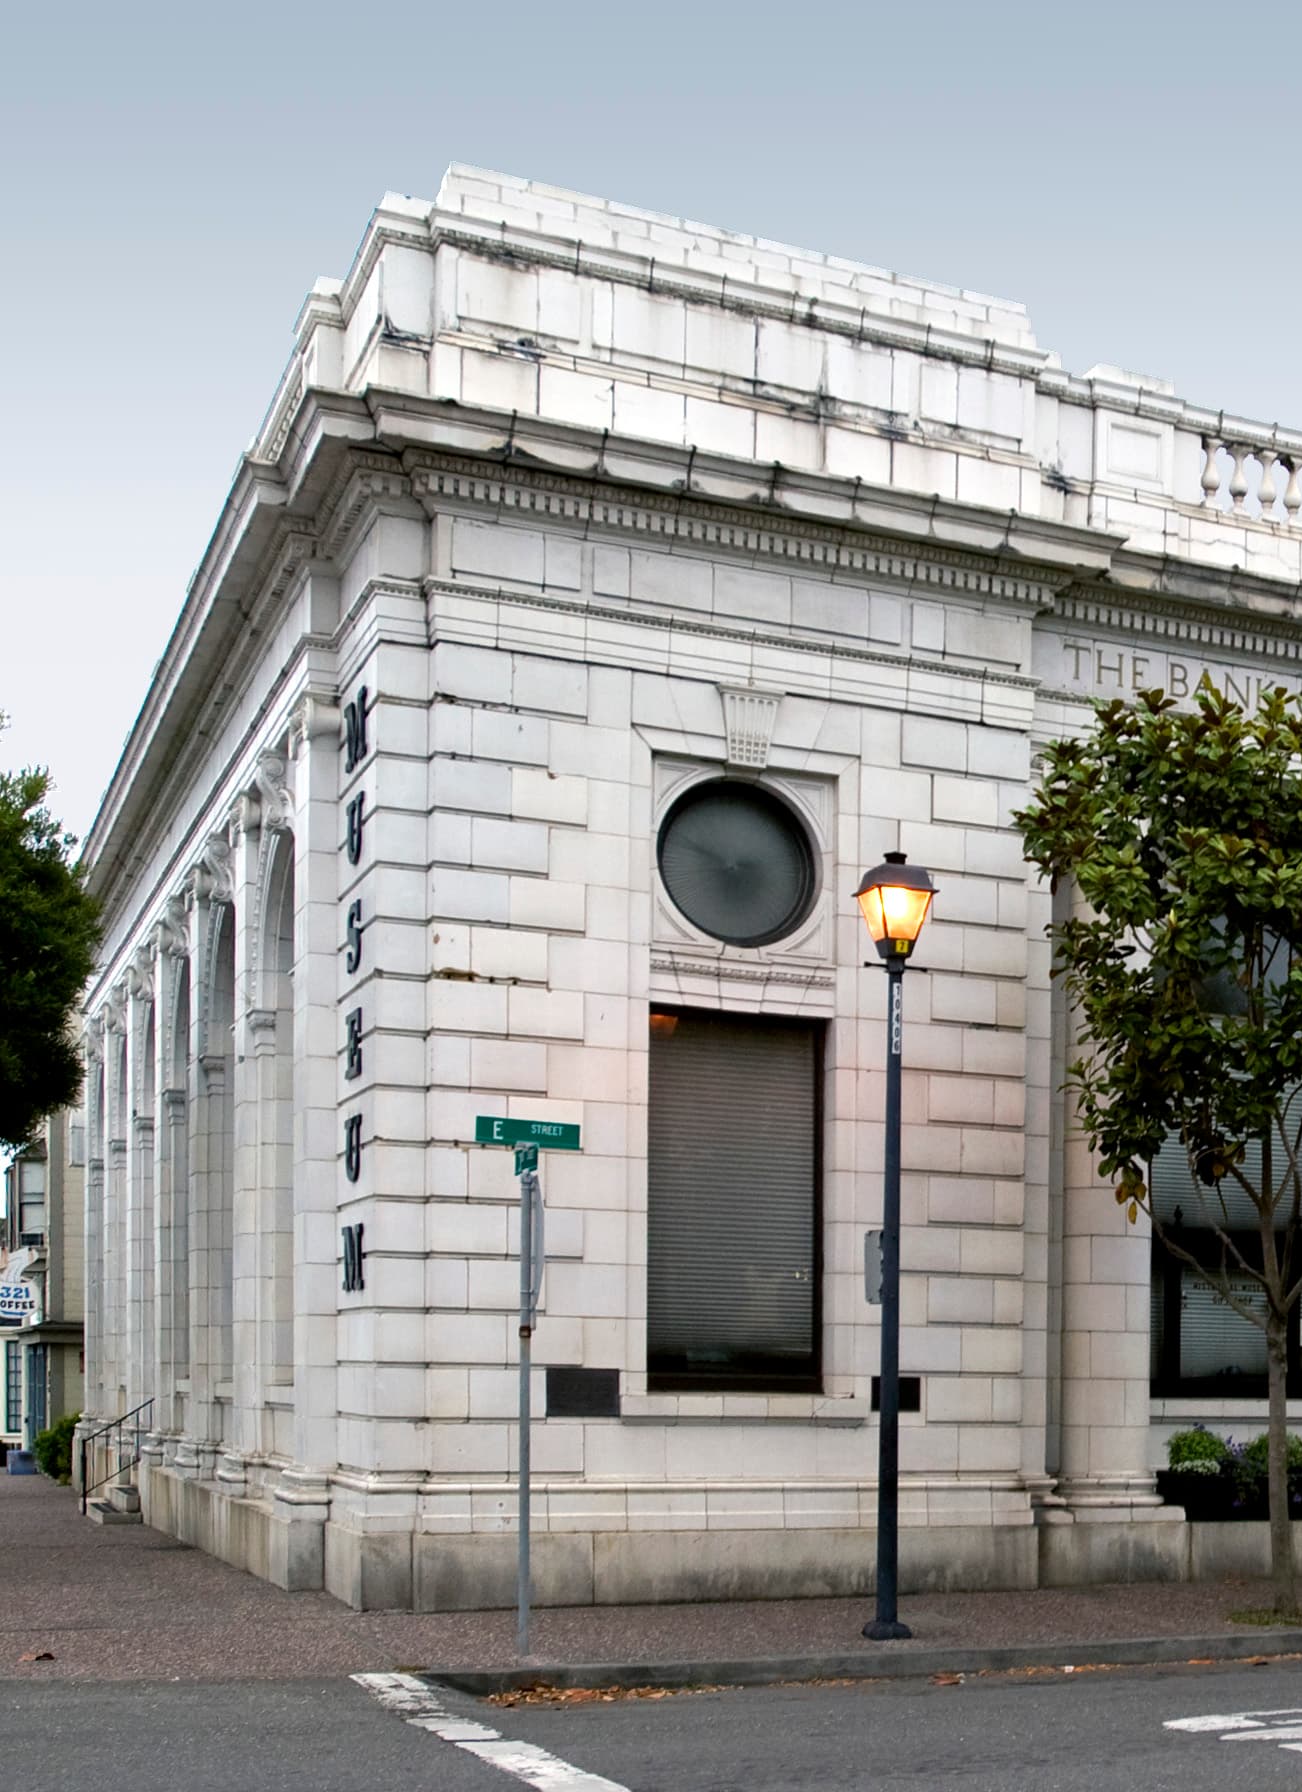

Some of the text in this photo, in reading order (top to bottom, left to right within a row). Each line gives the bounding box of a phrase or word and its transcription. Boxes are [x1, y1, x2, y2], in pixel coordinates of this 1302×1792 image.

[1063, 644, 1150, 691] THE
[1169, 662, 1276, 711] BANK
[342, 685, 368, 1293] MUSEUM
[493, 1121, 564, 1140] E STREET
[0, 1286, 30, 1299] 321
[0, 1300, 35, 1309] OFFEE
